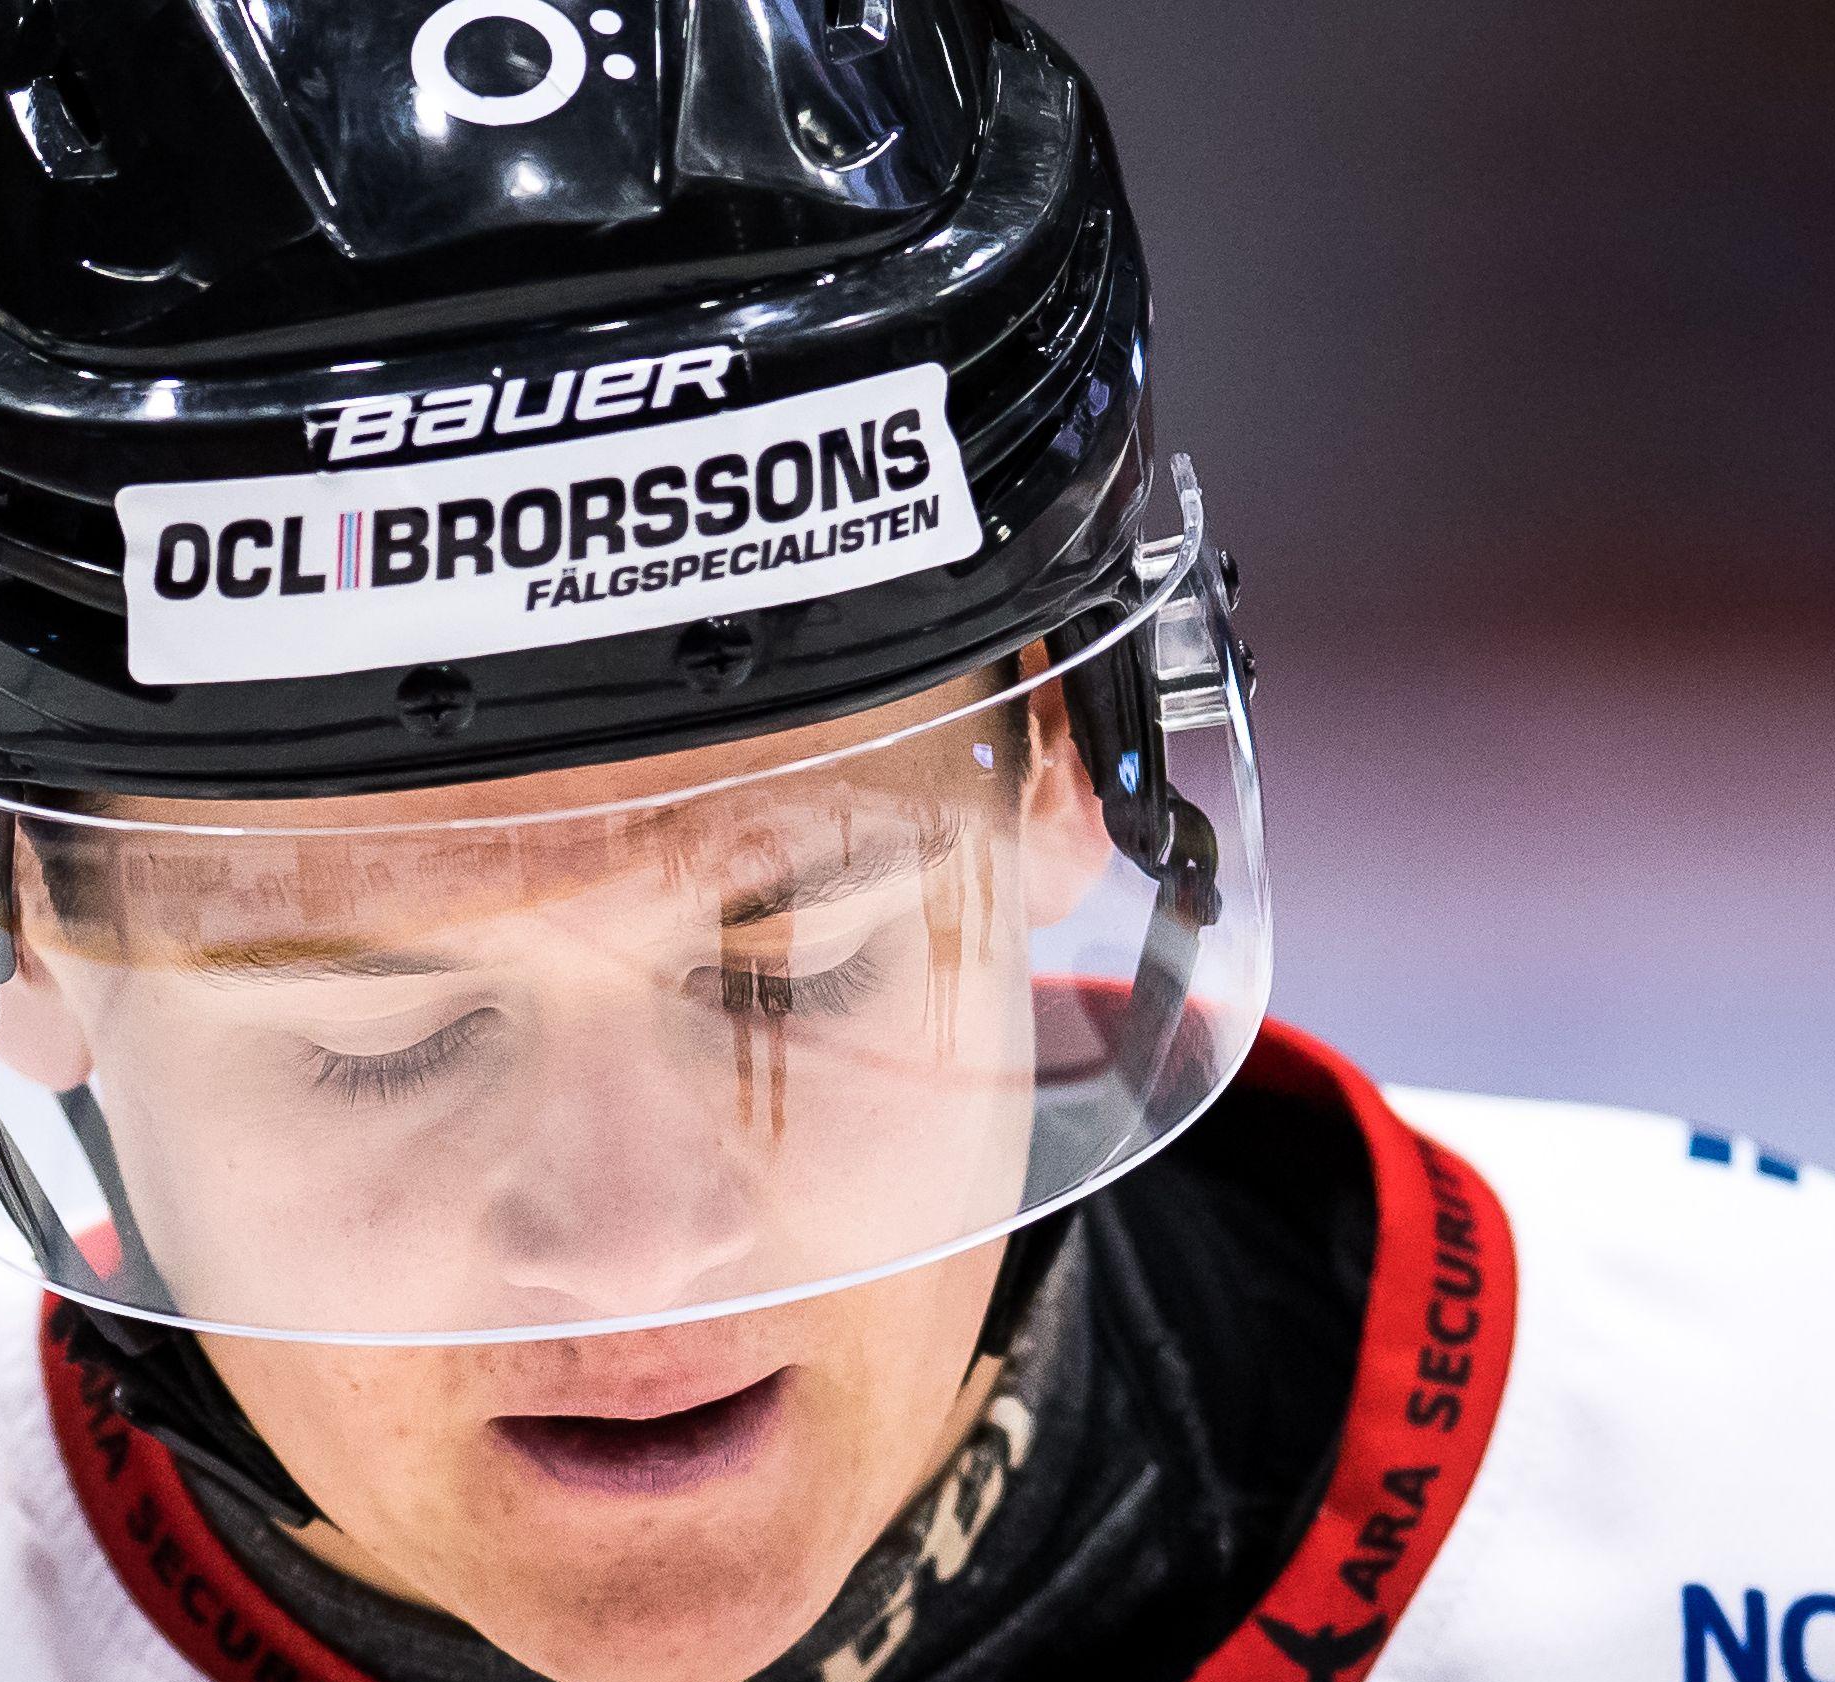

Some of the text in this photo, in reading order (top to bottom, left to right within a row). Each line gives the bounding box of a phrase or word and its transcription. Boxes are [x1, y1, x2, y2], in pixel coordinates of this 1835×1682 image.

[153, 408, 932, 601] OCL BRORSSONS
[524, 495, 942, 613] FÄLGSPECIALISTEN
[1339, 1462, 1440, 1605] ARA
